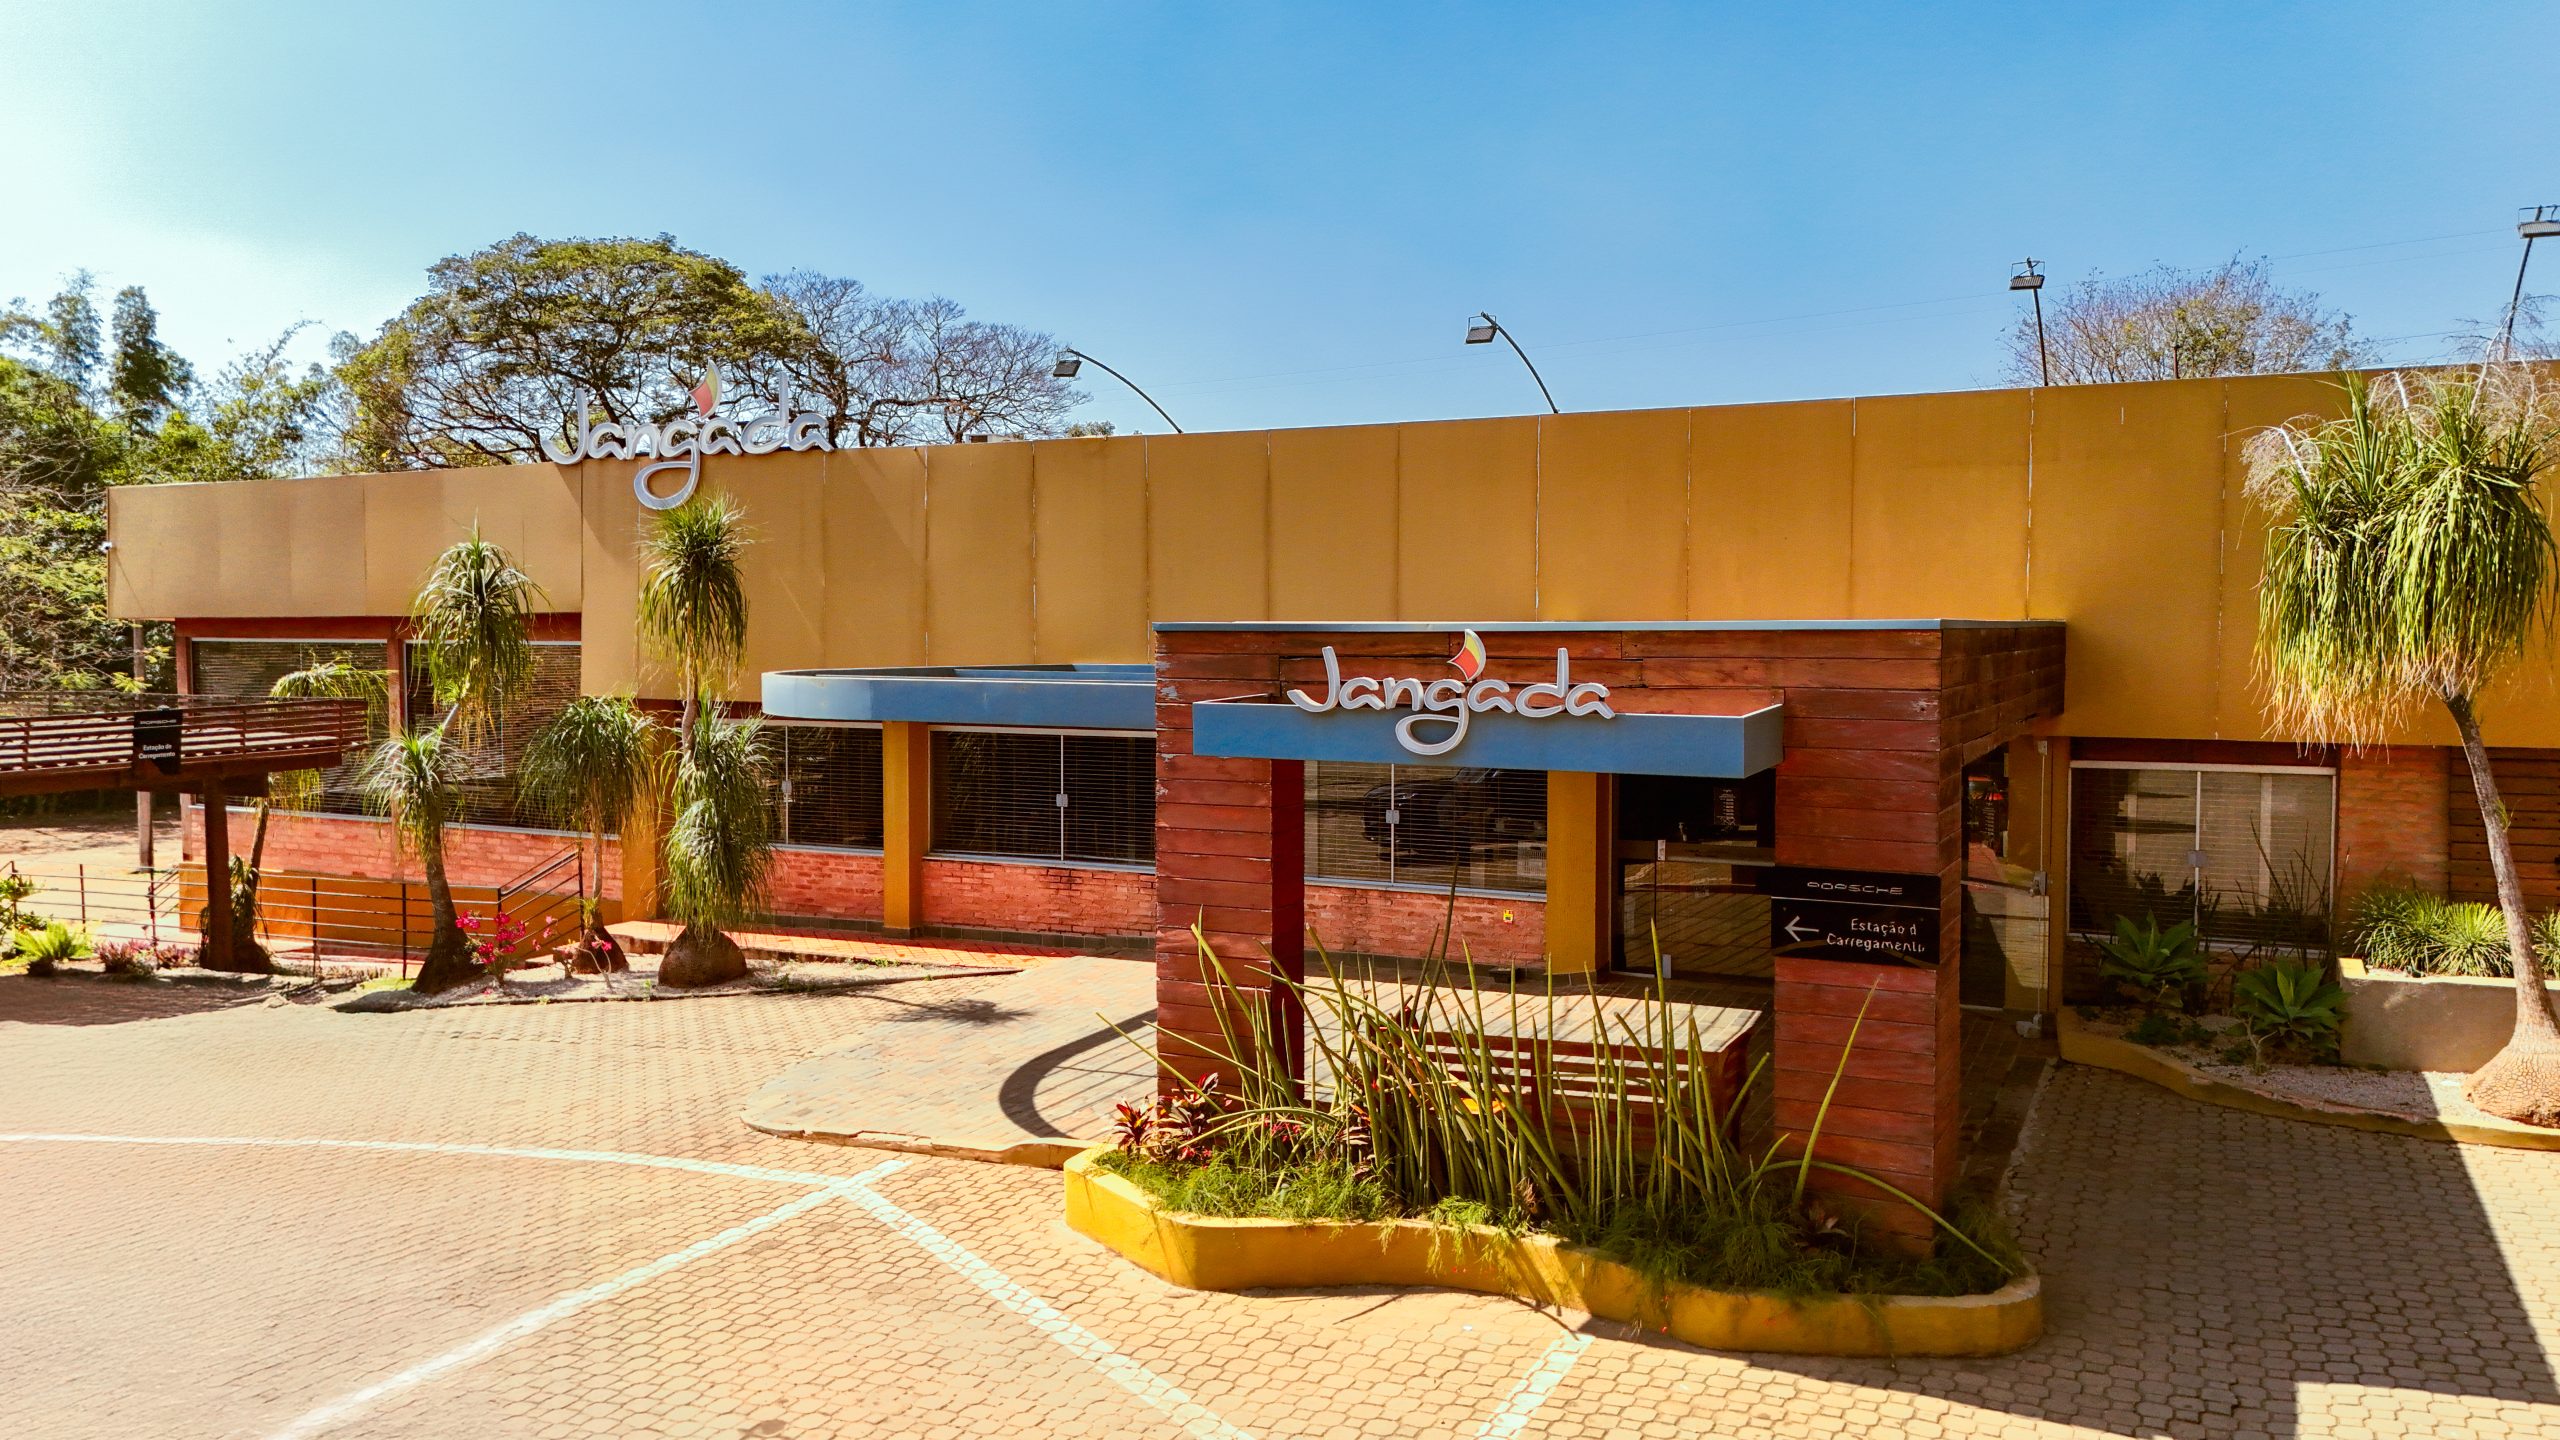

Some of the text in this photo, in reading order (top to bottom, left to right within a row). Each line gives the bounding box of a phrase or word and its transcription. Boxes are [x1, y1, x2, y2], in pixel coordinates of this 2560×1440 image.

[541, 371, 835, 510] Jangada
[1286, 646, 1616, 755] Jangada
[1806, 881, 1903, 895] PORSCHE
[1851, 918, 1905, 937] Estação
